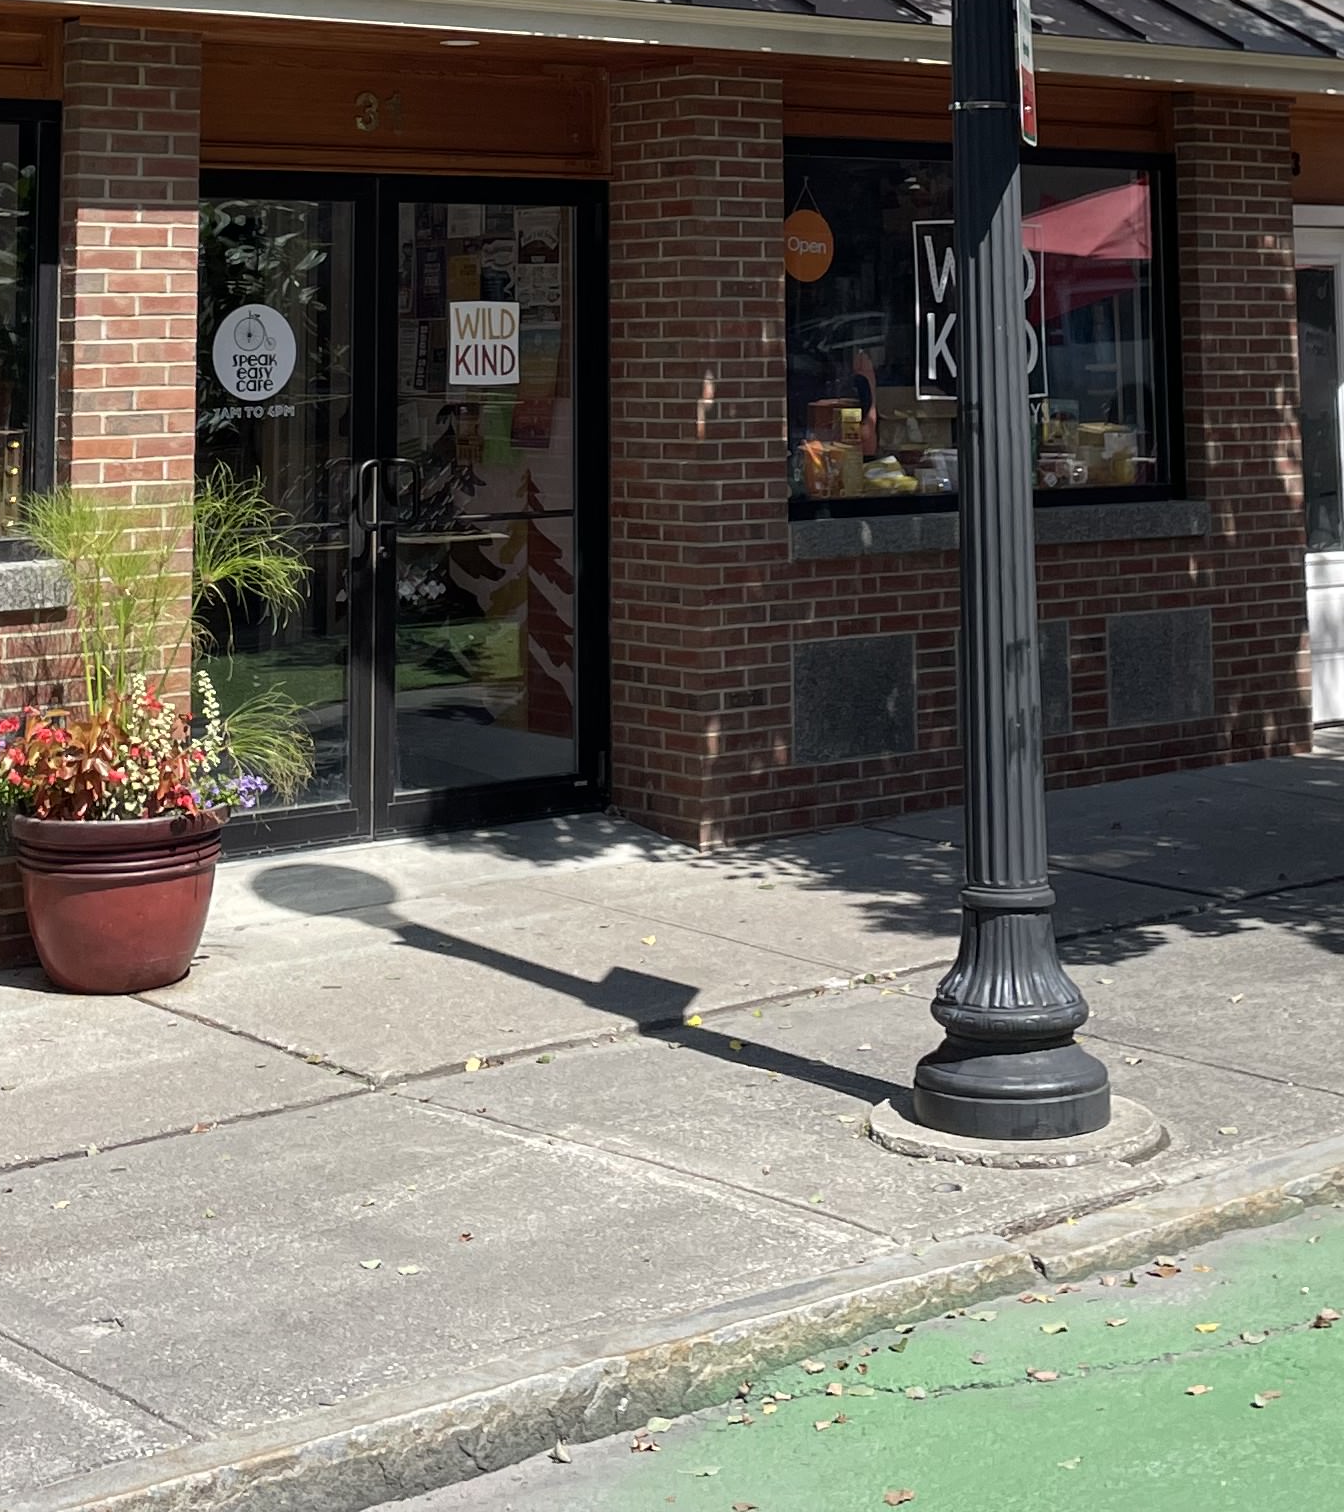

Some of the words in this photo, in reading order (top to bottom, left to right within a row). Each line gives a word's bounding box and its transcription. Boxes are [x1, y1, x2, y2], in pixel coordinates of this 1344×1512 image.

[787, 236, 826, 256] Open
[455, 307, 515, 340] WILD
[455, 345, 515, 376] KIND
[244, 406, 264, 419] TO
